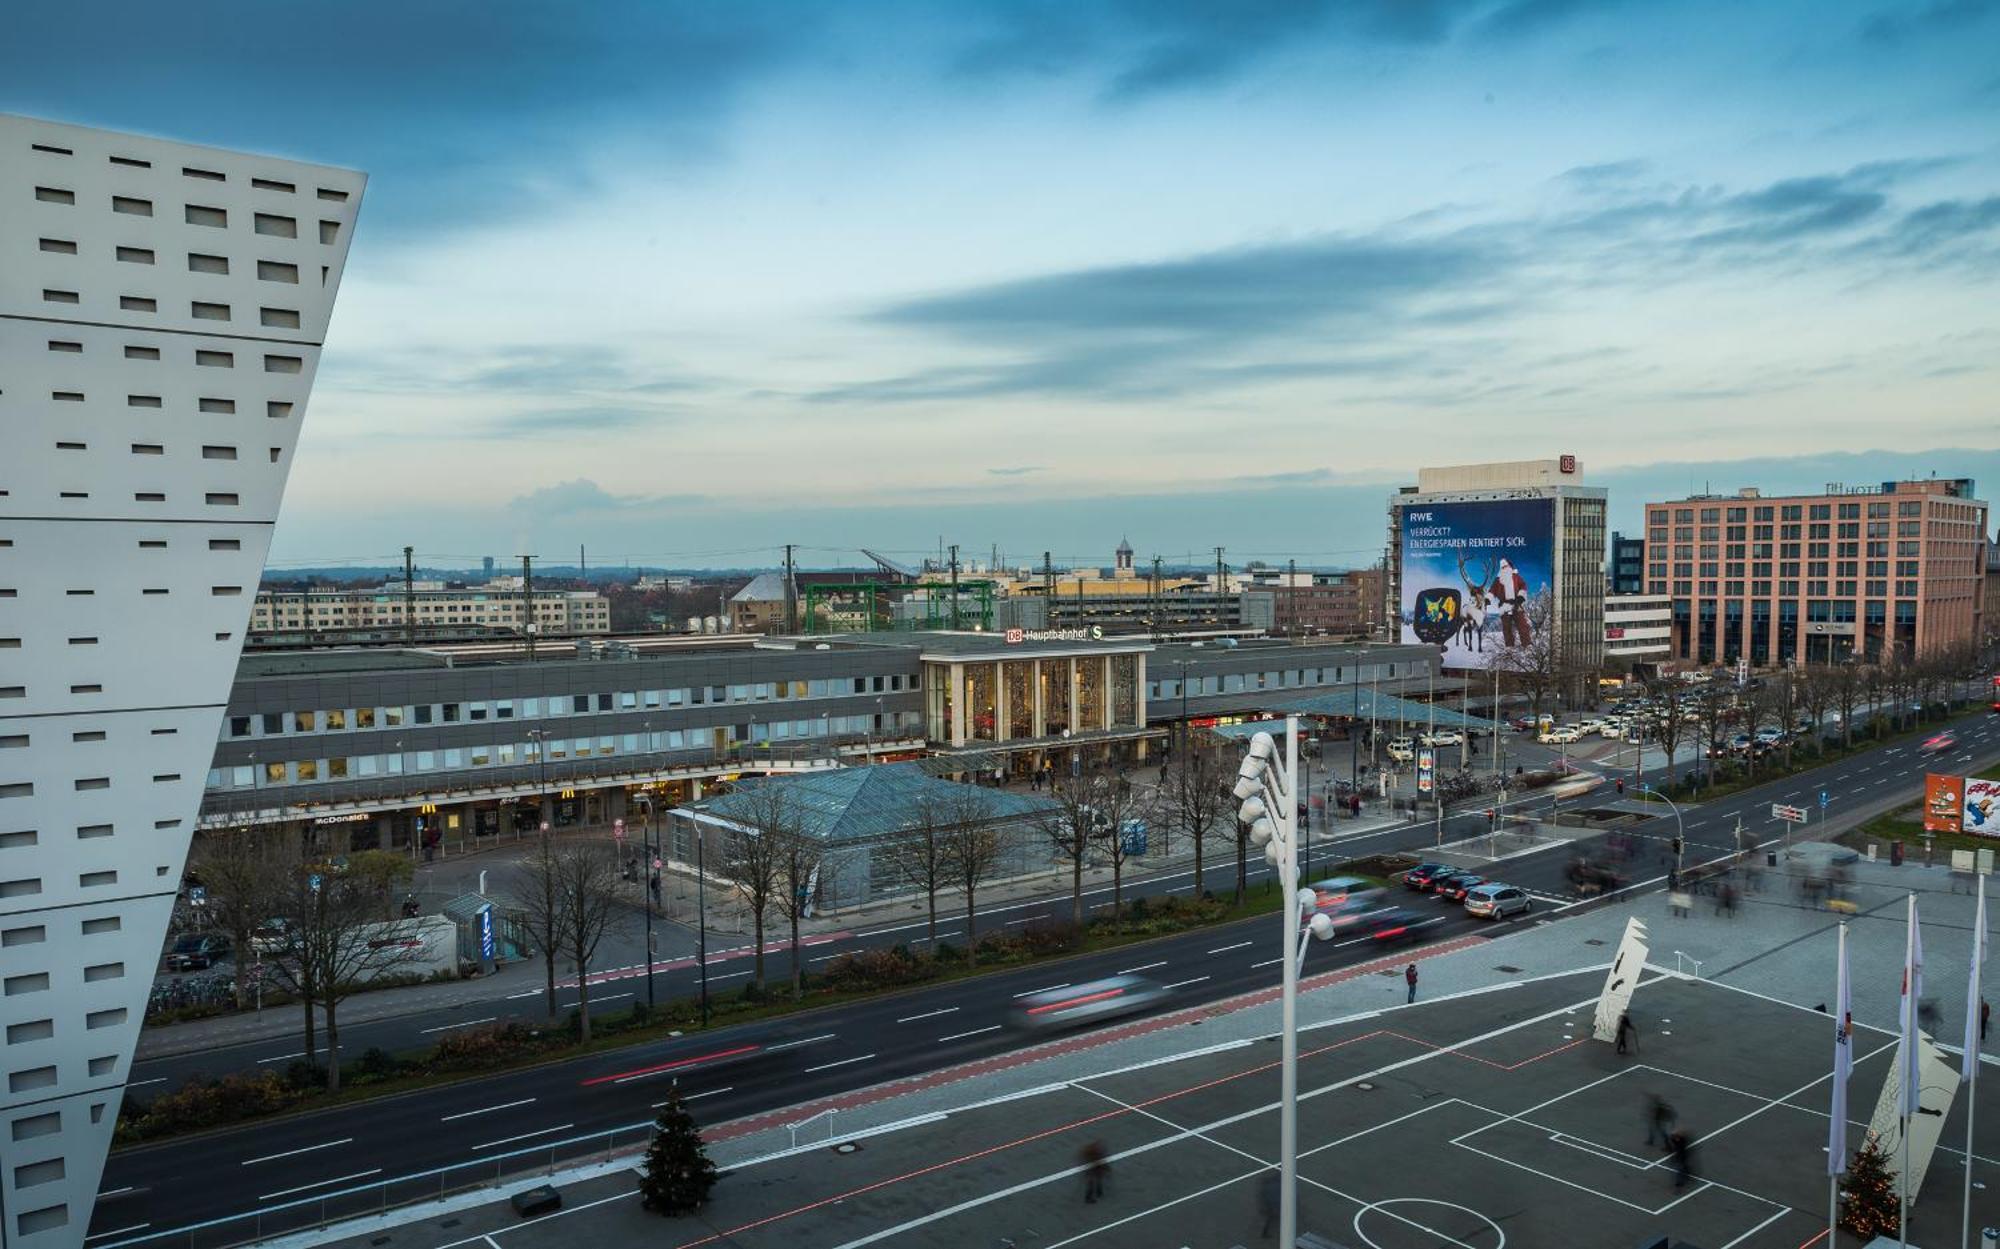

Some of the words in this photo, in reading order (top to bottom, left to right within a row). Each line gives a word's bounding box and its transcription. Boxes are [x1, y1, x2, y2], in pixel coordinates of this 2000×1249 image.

[1562, 457, 1574, 471] DB
[1410, 512, 1433, 521] RWE
[1410, 538, 1466, 549] ENERGIESPAREN
[1469, 537, 1504, 548] RENTIERT
[1506, 535, 1527, 547] SICH.
[1008, 630, 1021, 641] DB
[1026, 628, 1087, 642] Hauptbahnhof
[1092, 625, 1103, 640] S
[315, 812, 369, 825] McDonald's
